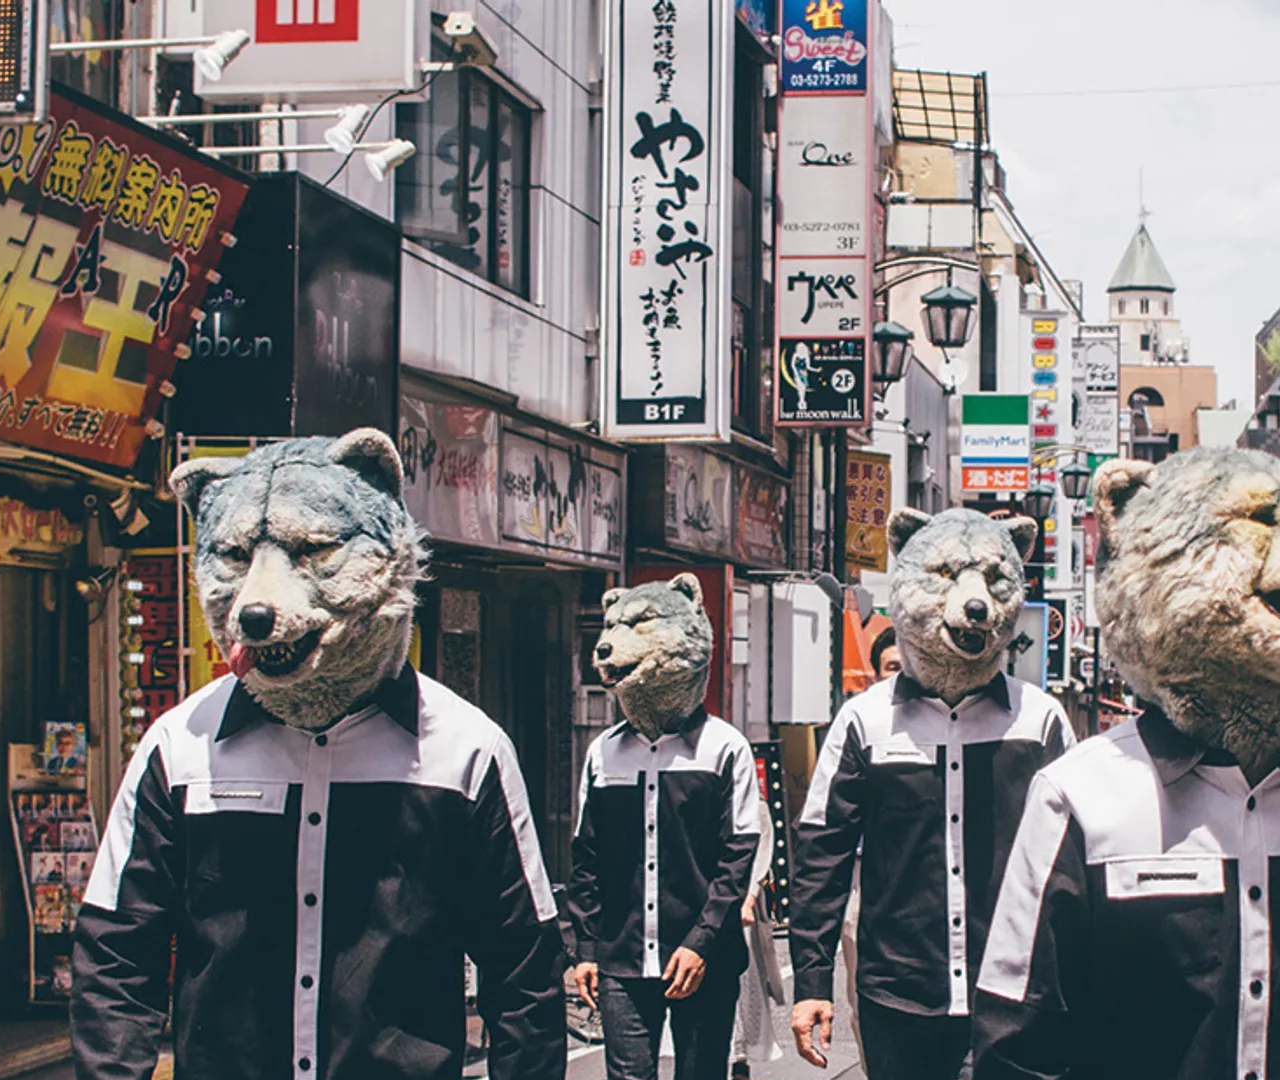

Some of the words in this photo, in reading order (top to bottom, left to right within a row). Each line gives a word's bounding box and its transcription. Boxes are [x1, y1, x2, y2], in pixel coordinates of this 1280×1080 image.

[785, 26, 866, 65] Sweet
[812, 60, 836, 73] 4F
[42, 118, 220, 253] 無料案内所
[629, 107, 713, 281] やさいや
[836, 236, 859, 250] 3F
[838, 317, 861, 332] 2F
[835, 374, 852, 388] 2F
[643, 404, 685, 421] B1F
[964, 435, 1027, 447] FamilyMart
